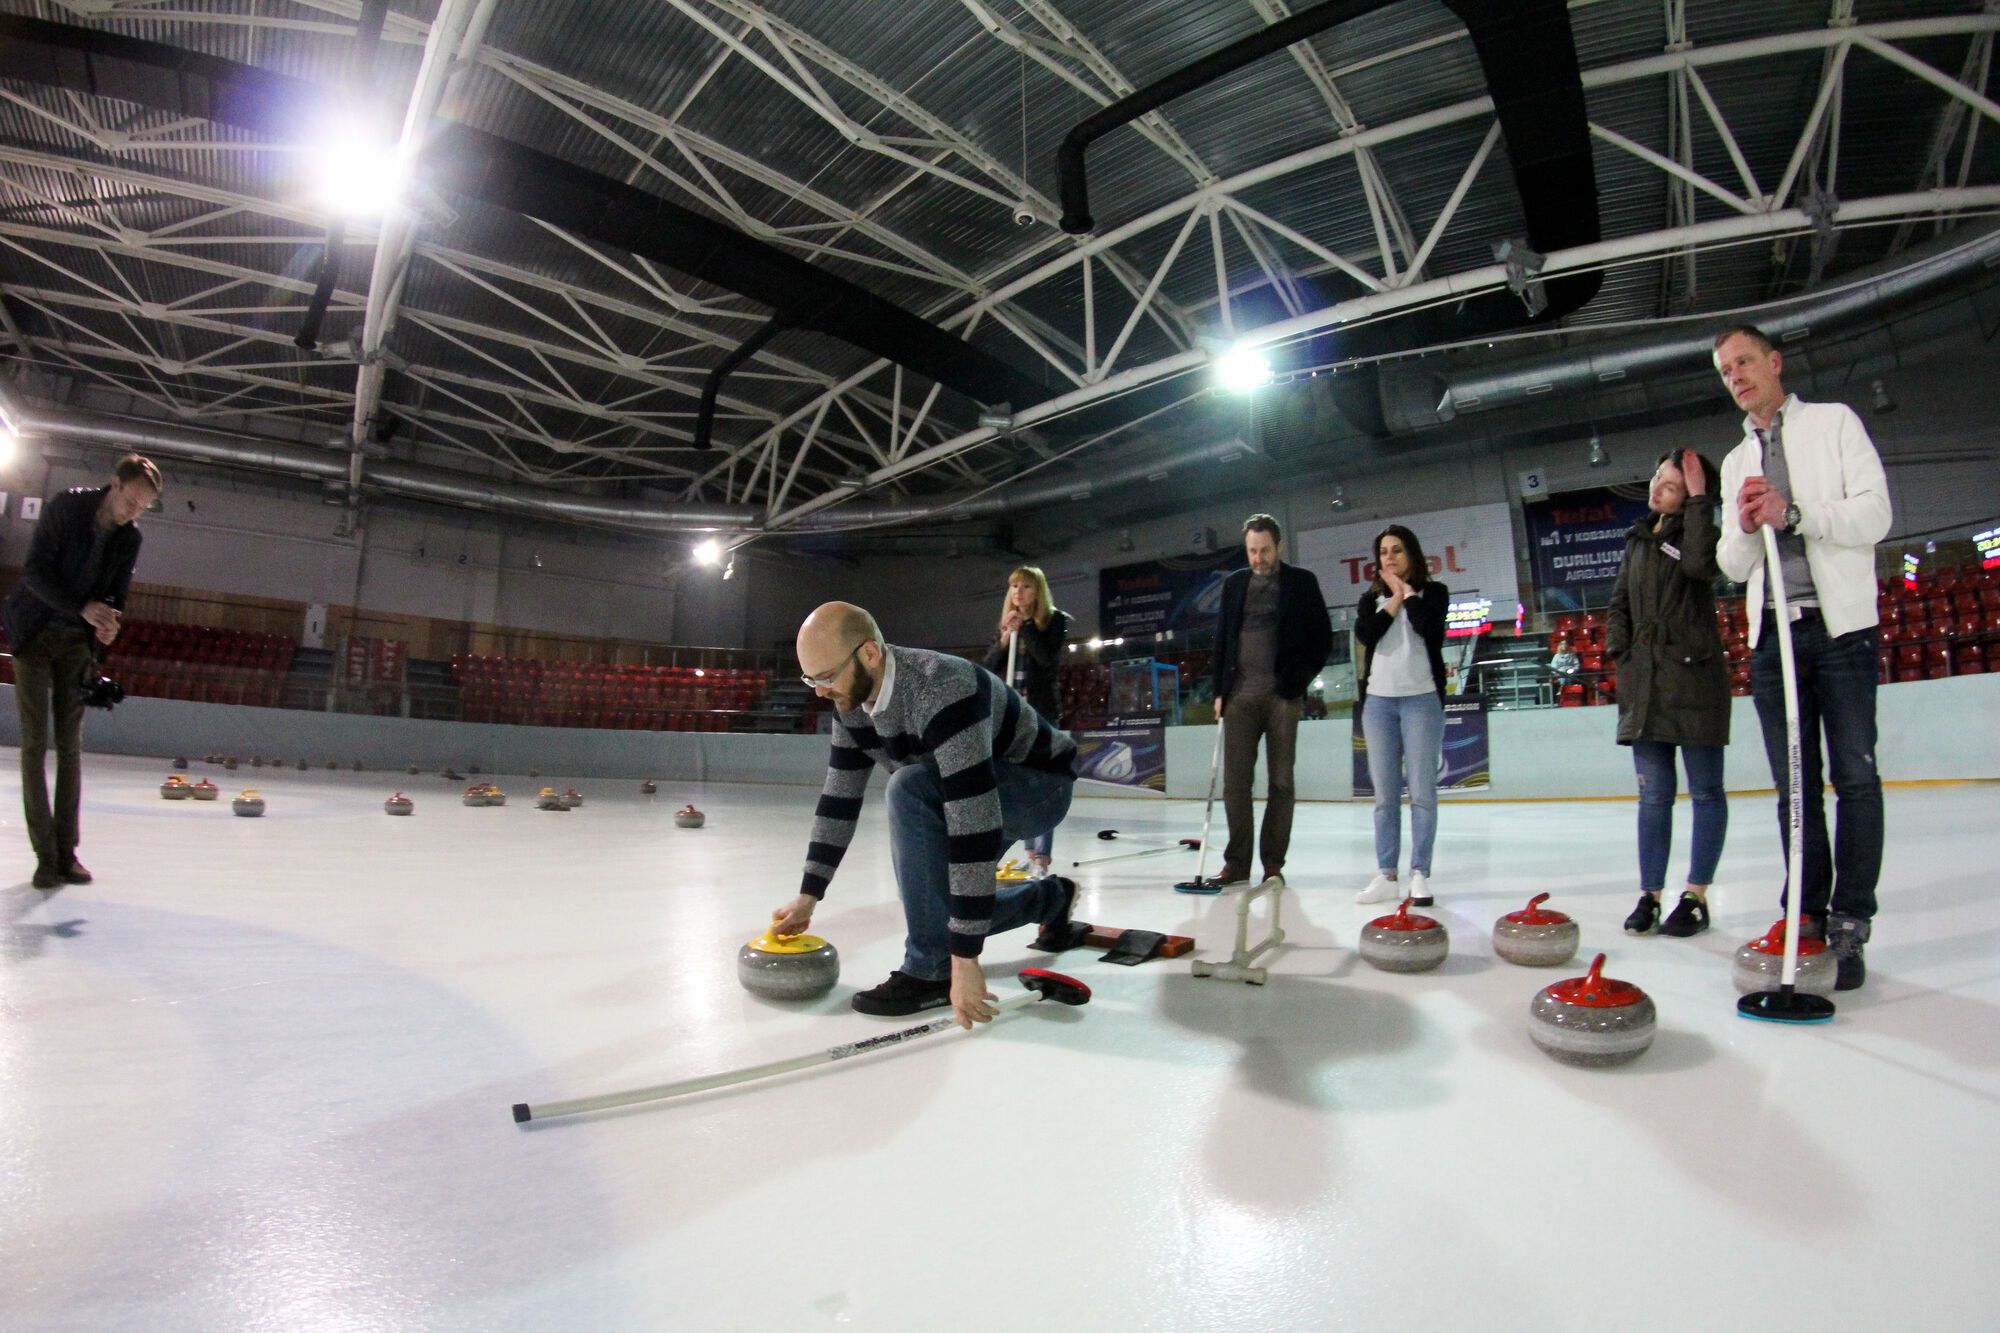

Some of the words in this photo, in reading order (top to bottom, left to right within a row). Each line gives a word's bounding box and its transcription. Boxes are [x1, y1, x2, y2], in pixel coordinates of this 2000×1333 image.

[1527, 475, 1540, 489] 3
[1340, 545, 1467, 585] Teal
[1553, 550, 1625, 569] DURILIUM
[1565, 566, 1617, 582] AIRGLIDE
